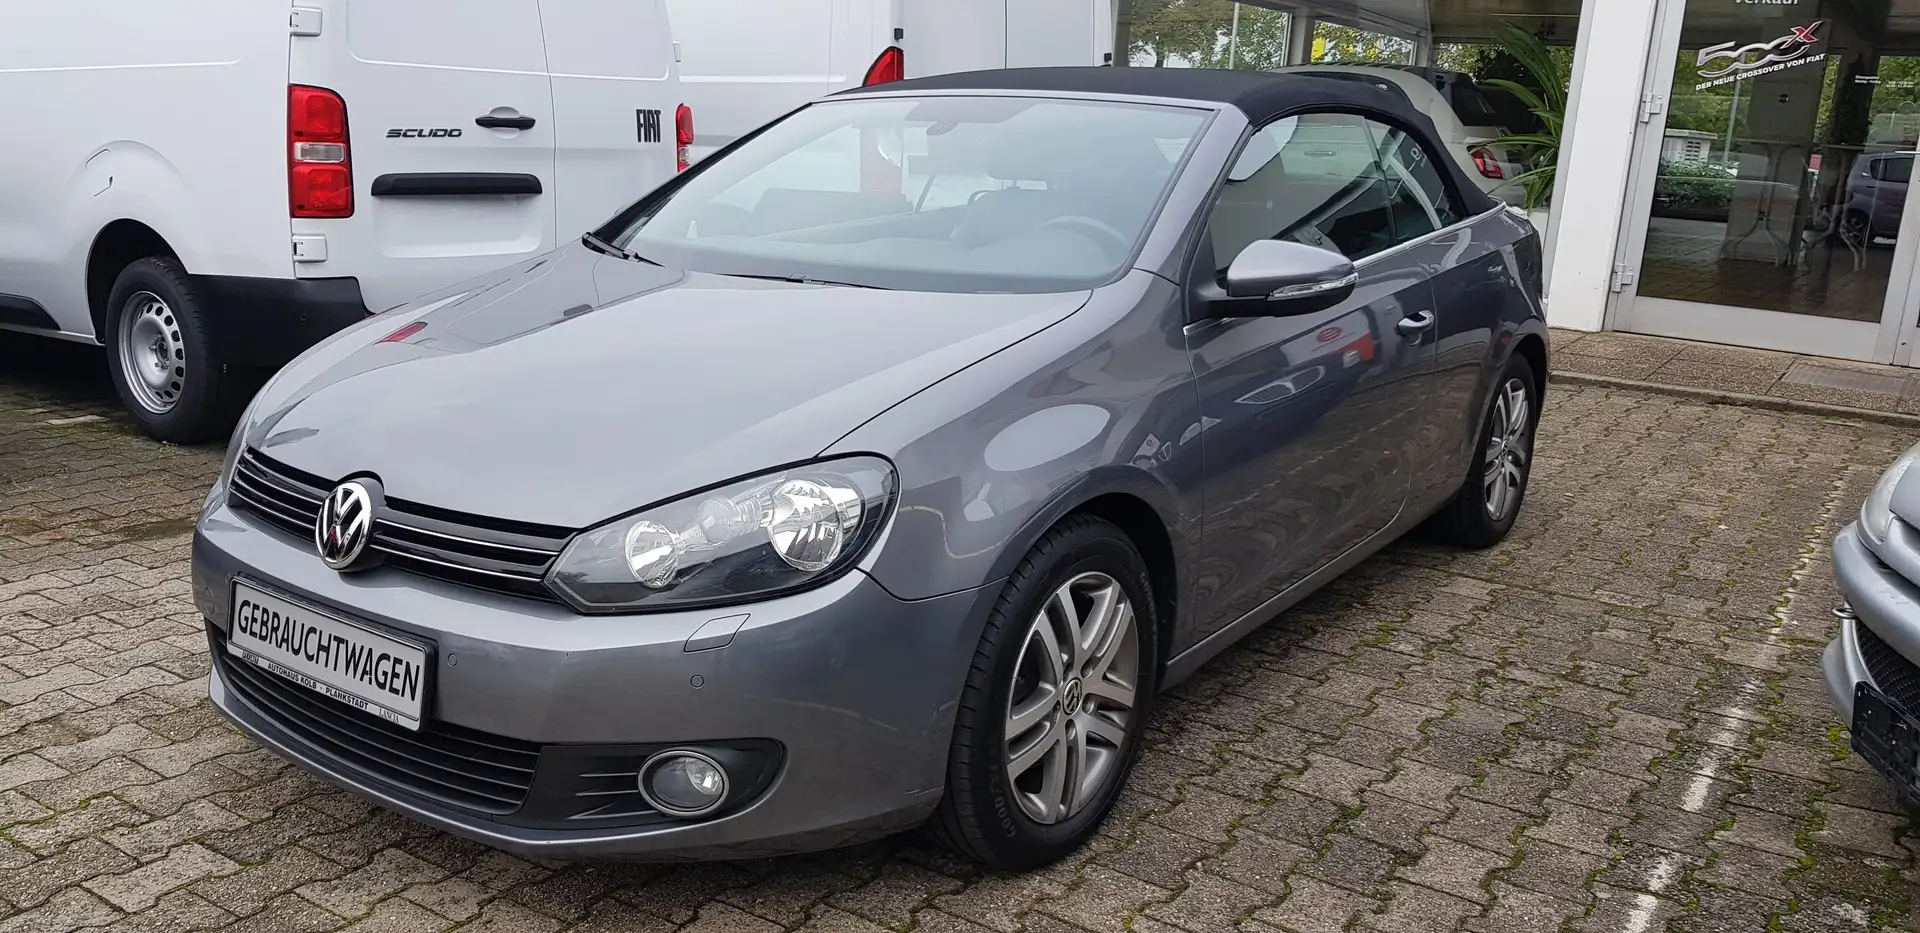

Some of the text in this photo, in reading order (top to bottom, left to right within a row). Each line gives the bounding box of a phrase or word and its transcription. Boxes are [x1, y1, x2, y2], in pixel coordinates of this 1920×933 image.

[1695, 53, 1826, 91] DER NEUE CROSSOVER VON FIAT
[385, 128, 462, 138] SCUDO
[636, 109, 661, 143] FIAT
[237, 599, 420, 702] GEBRAUCHTWAGEN
[267, 662, 369, 710] AUTOHAUS KOLB PLANKSTADT
